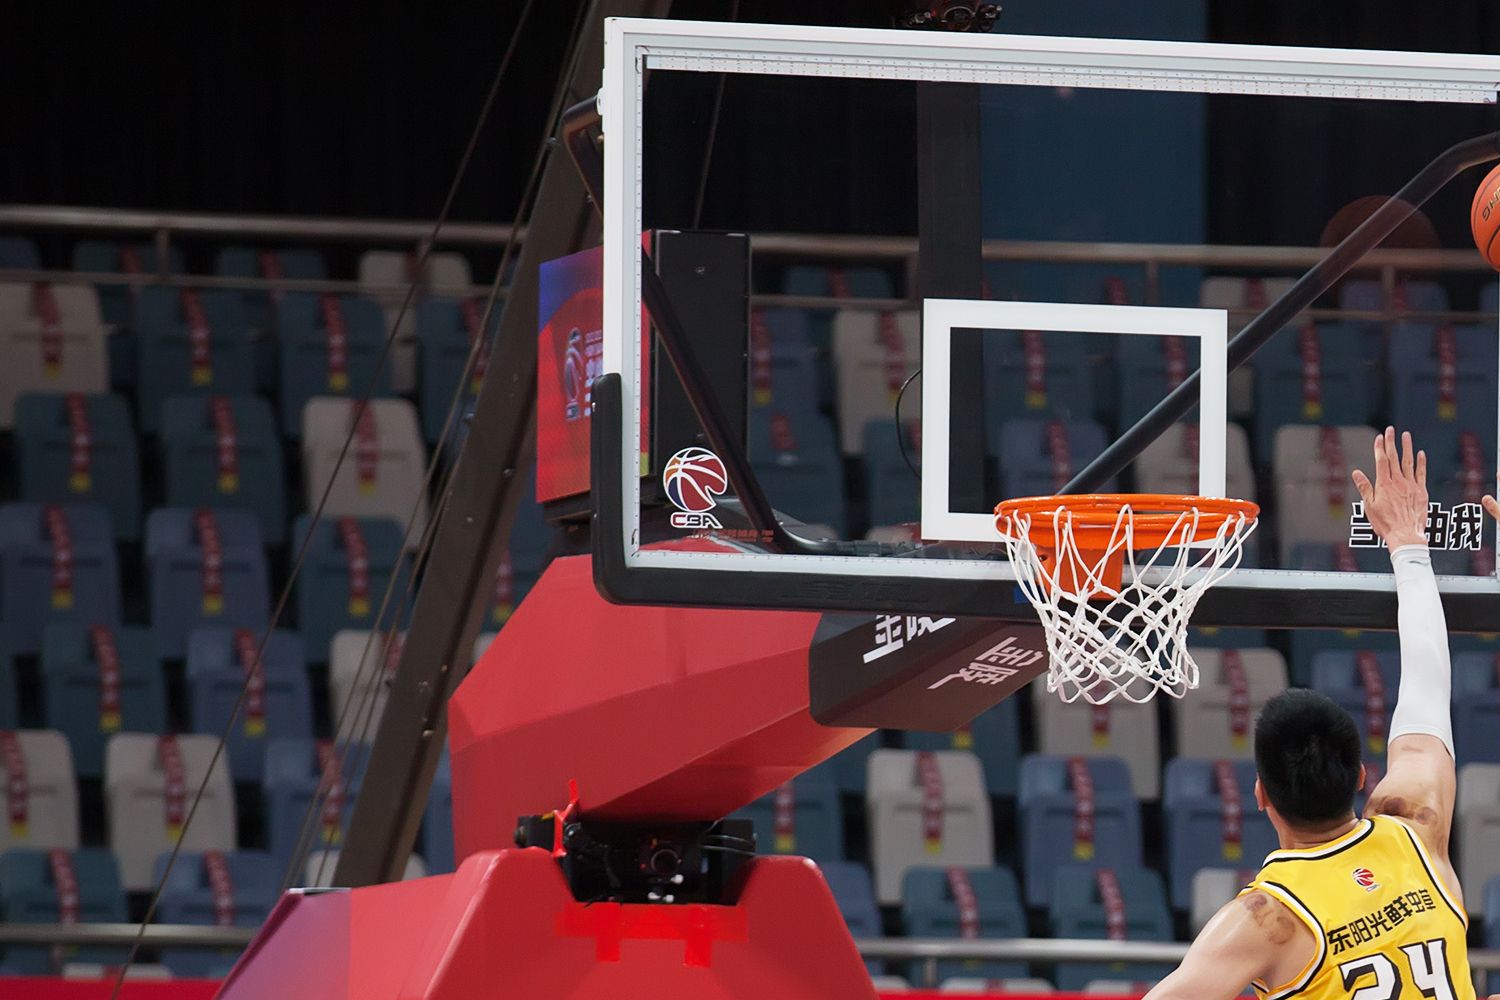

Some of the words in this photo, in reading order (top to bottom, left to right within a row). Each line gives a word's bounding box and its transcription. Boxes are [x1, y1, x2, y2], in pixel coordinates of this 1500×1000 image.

[670, 511, 723, 529] CBA
[1349, 500, 1482, 550] 当由我
